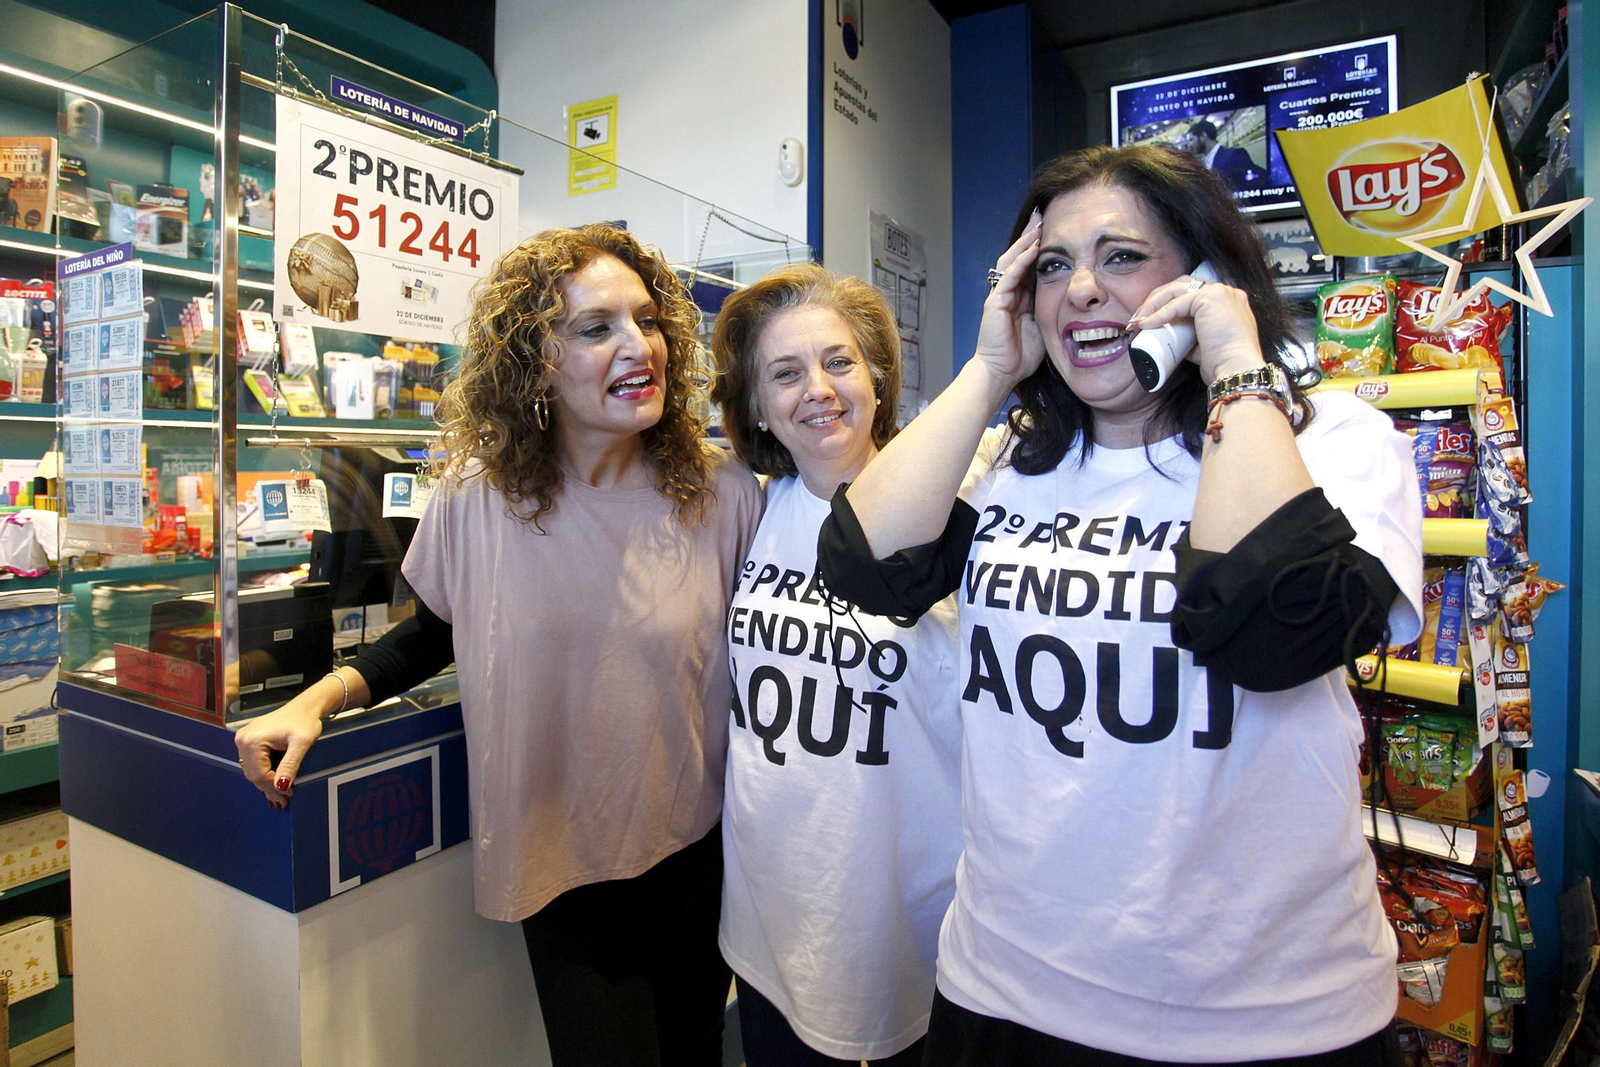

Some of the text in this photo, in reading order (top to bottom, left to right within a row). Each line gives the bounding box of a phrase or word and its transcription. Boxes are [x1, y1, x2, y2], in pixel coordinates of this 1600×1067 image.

[833, 61, 868, 100] Loterías y
[1167, 90, 1177, 98] DE
[1181, 81, 1227, 96] DICIEMBRE
[1263, 83, 1287, 92] LOTERÍA
[340, 85, 458, 136] LOTERÍA DE NAVIDAD
[833, 80, 878, 123] Apuestas del
[833, 97, 858, 125] Estado
[1148, 93, 1235, 114] SORTEO DE NAVIDAD
[1279, 87, 1382, 110] Cuartos Premios
[1297, 108, 1364, 127] 200.000€
[349, 148, 494, 221] PREMIO
[1262, 187, 1285, 196] muy
[1337, 150, 1448, 216] Lay's
[140, 192, 186, 207] Energizer
[332, 193, 480, 268] 51244
[887, 226, 909, 257] BOTES
[64, 249, 124, 275] LOTERÍA DEL NIÑO
[4, 289, 48, 299] LOCTITE
[414, 313, 444, 324] DICIEMBRE
[1436, 427, 1472, 455] fles
[974, 504, 1026, 544] 2º
[734, 560, 757, 593] º
[966, 560, 1179, 624] VENDID
[728, 606, 908, 683] ENDIDO
